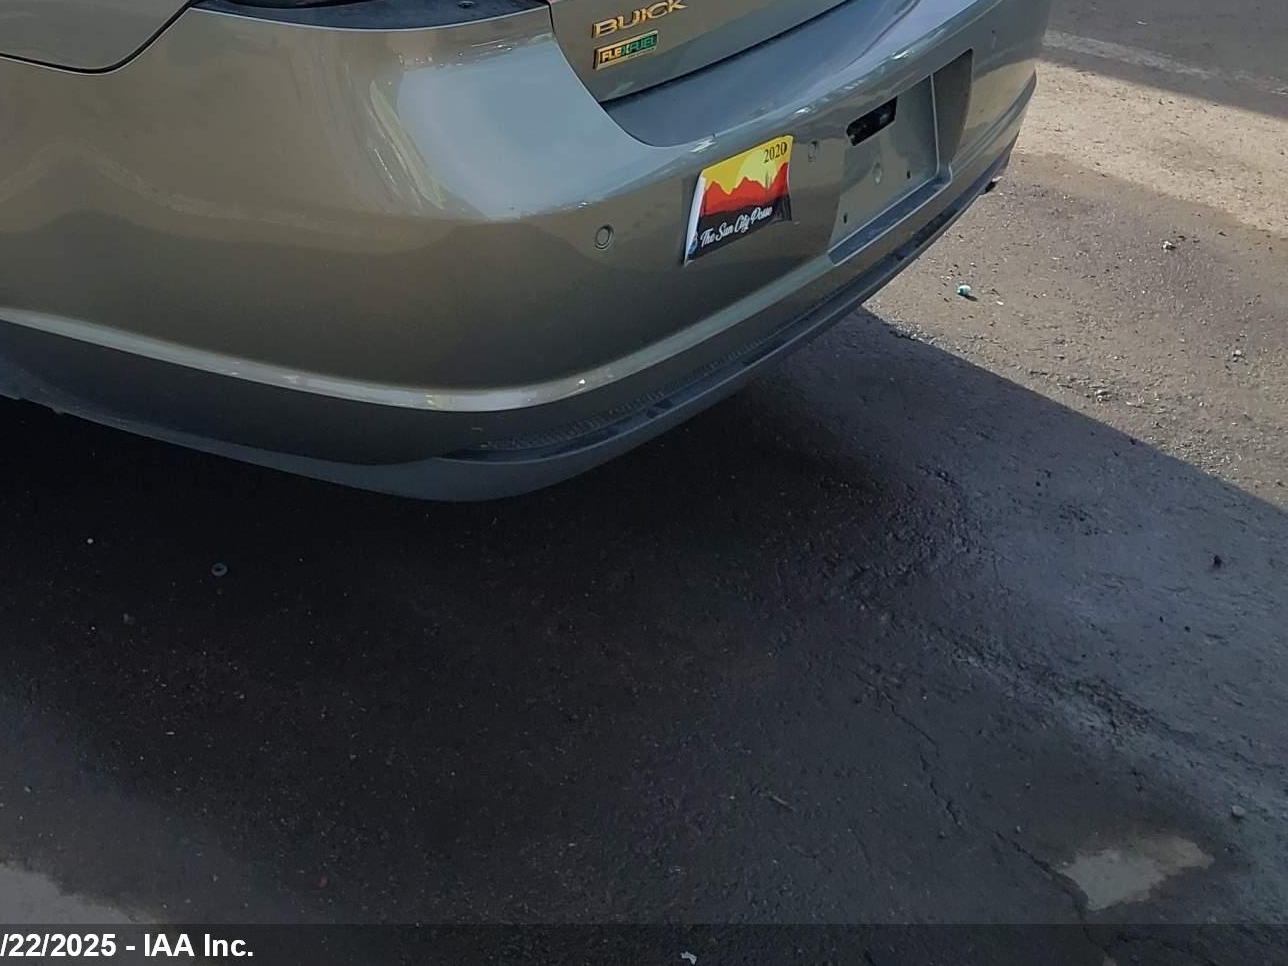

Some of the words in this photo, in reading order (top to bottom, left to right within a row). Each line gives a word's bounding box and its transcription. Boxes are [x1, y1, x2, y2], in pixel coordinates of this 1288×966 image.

[764, 142, 787, 163] 2020
[700, 227, 715, 248] The
[715, 221, 734, 241] Sun
